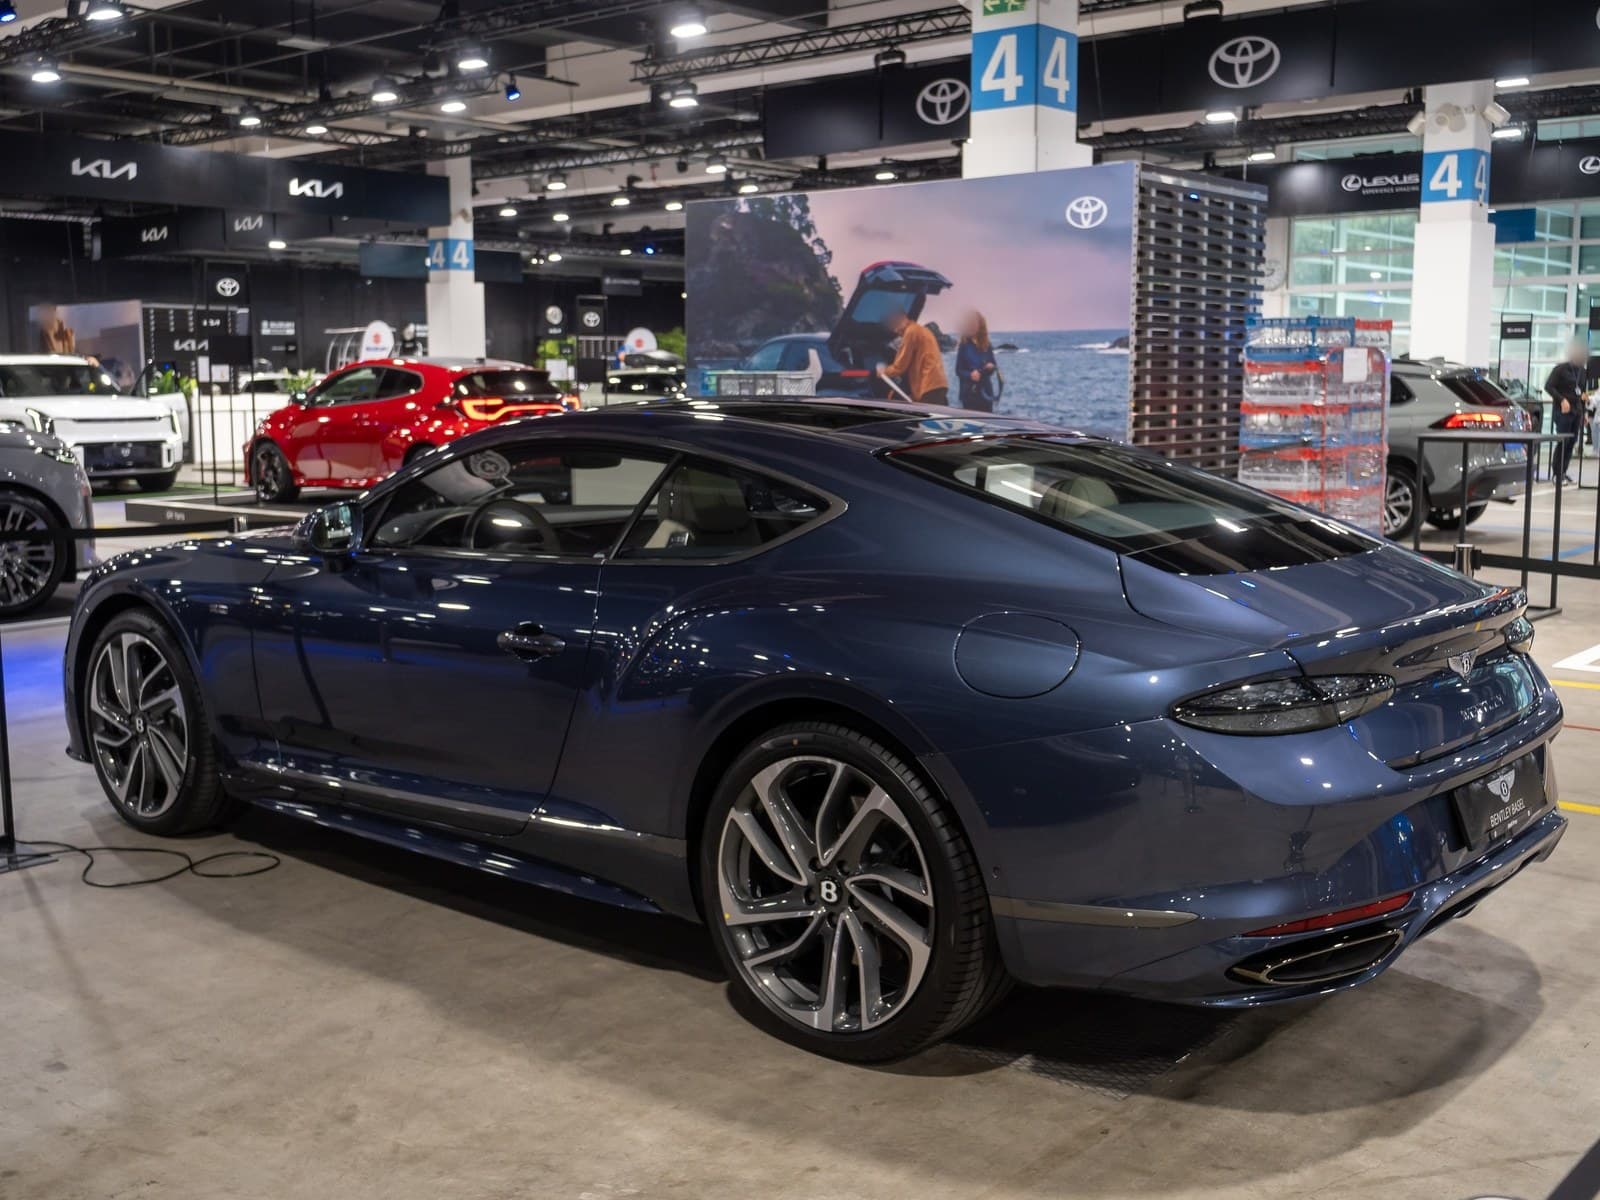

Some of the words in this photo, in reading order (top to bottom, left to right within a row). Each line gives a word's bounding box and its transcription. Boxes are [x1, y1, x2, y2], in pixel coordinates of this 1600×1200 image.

[981, 34, 1024, 102] 4
[1043, 36, 1070, 103] 4
[71, 157, 138, 181] KIA
[1362, 173, 1420, 188] LEXUS
[1429, 154, 1462, 198] 4
[1474, 155, 1487, 203] 4
[289, 177, 344, 199] KIA
[141, 226, 168, 242] KIA
[234, 215, 263, 232] KIA
[432, 241, 446, 268] 4
[452, 241, 470, 268] 4
[1489, 806, 1512, 827] BENTLEY
[1511, 798, 1525, 815] BASEL
[821, 880, 838, 902] B
